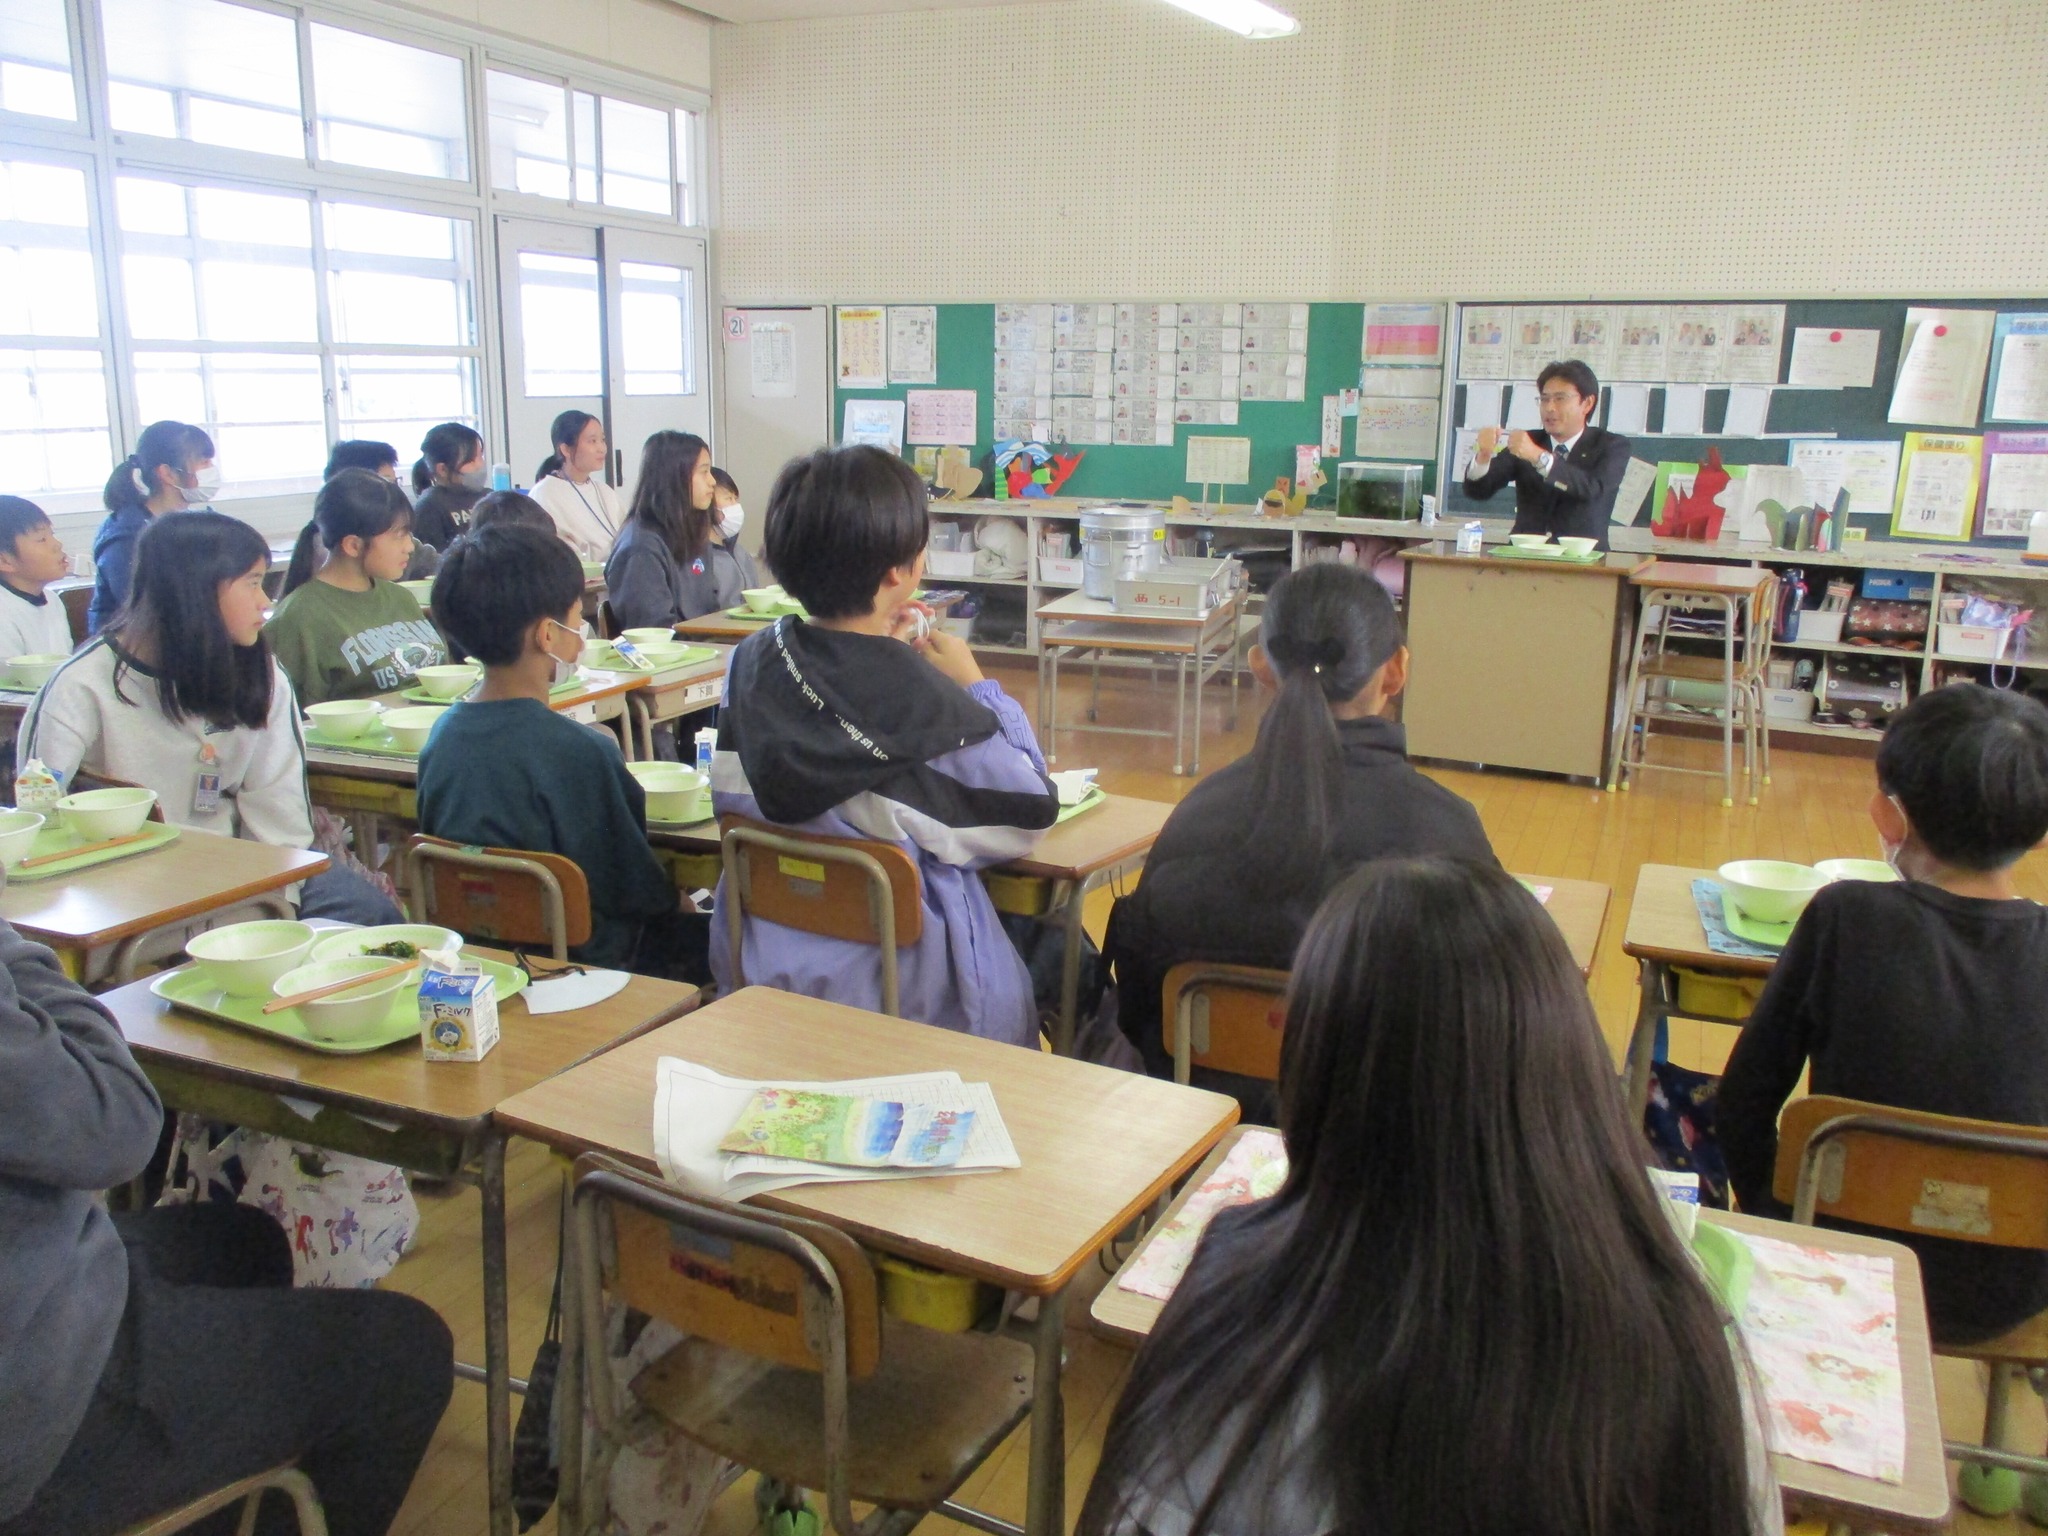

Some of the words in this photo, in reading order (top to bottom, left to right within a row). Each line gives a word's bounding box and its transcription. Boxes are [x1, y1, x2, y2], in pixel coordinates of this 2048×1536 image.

[1158, 595, 1180, 606] 5-1
[776, 634, 784, 649] on
[781, 648, 802, 683] smiled
[372, 666, 398, 690] US
[802, 681, 825, 711] Luck
[860, 738, 873, 750] us
